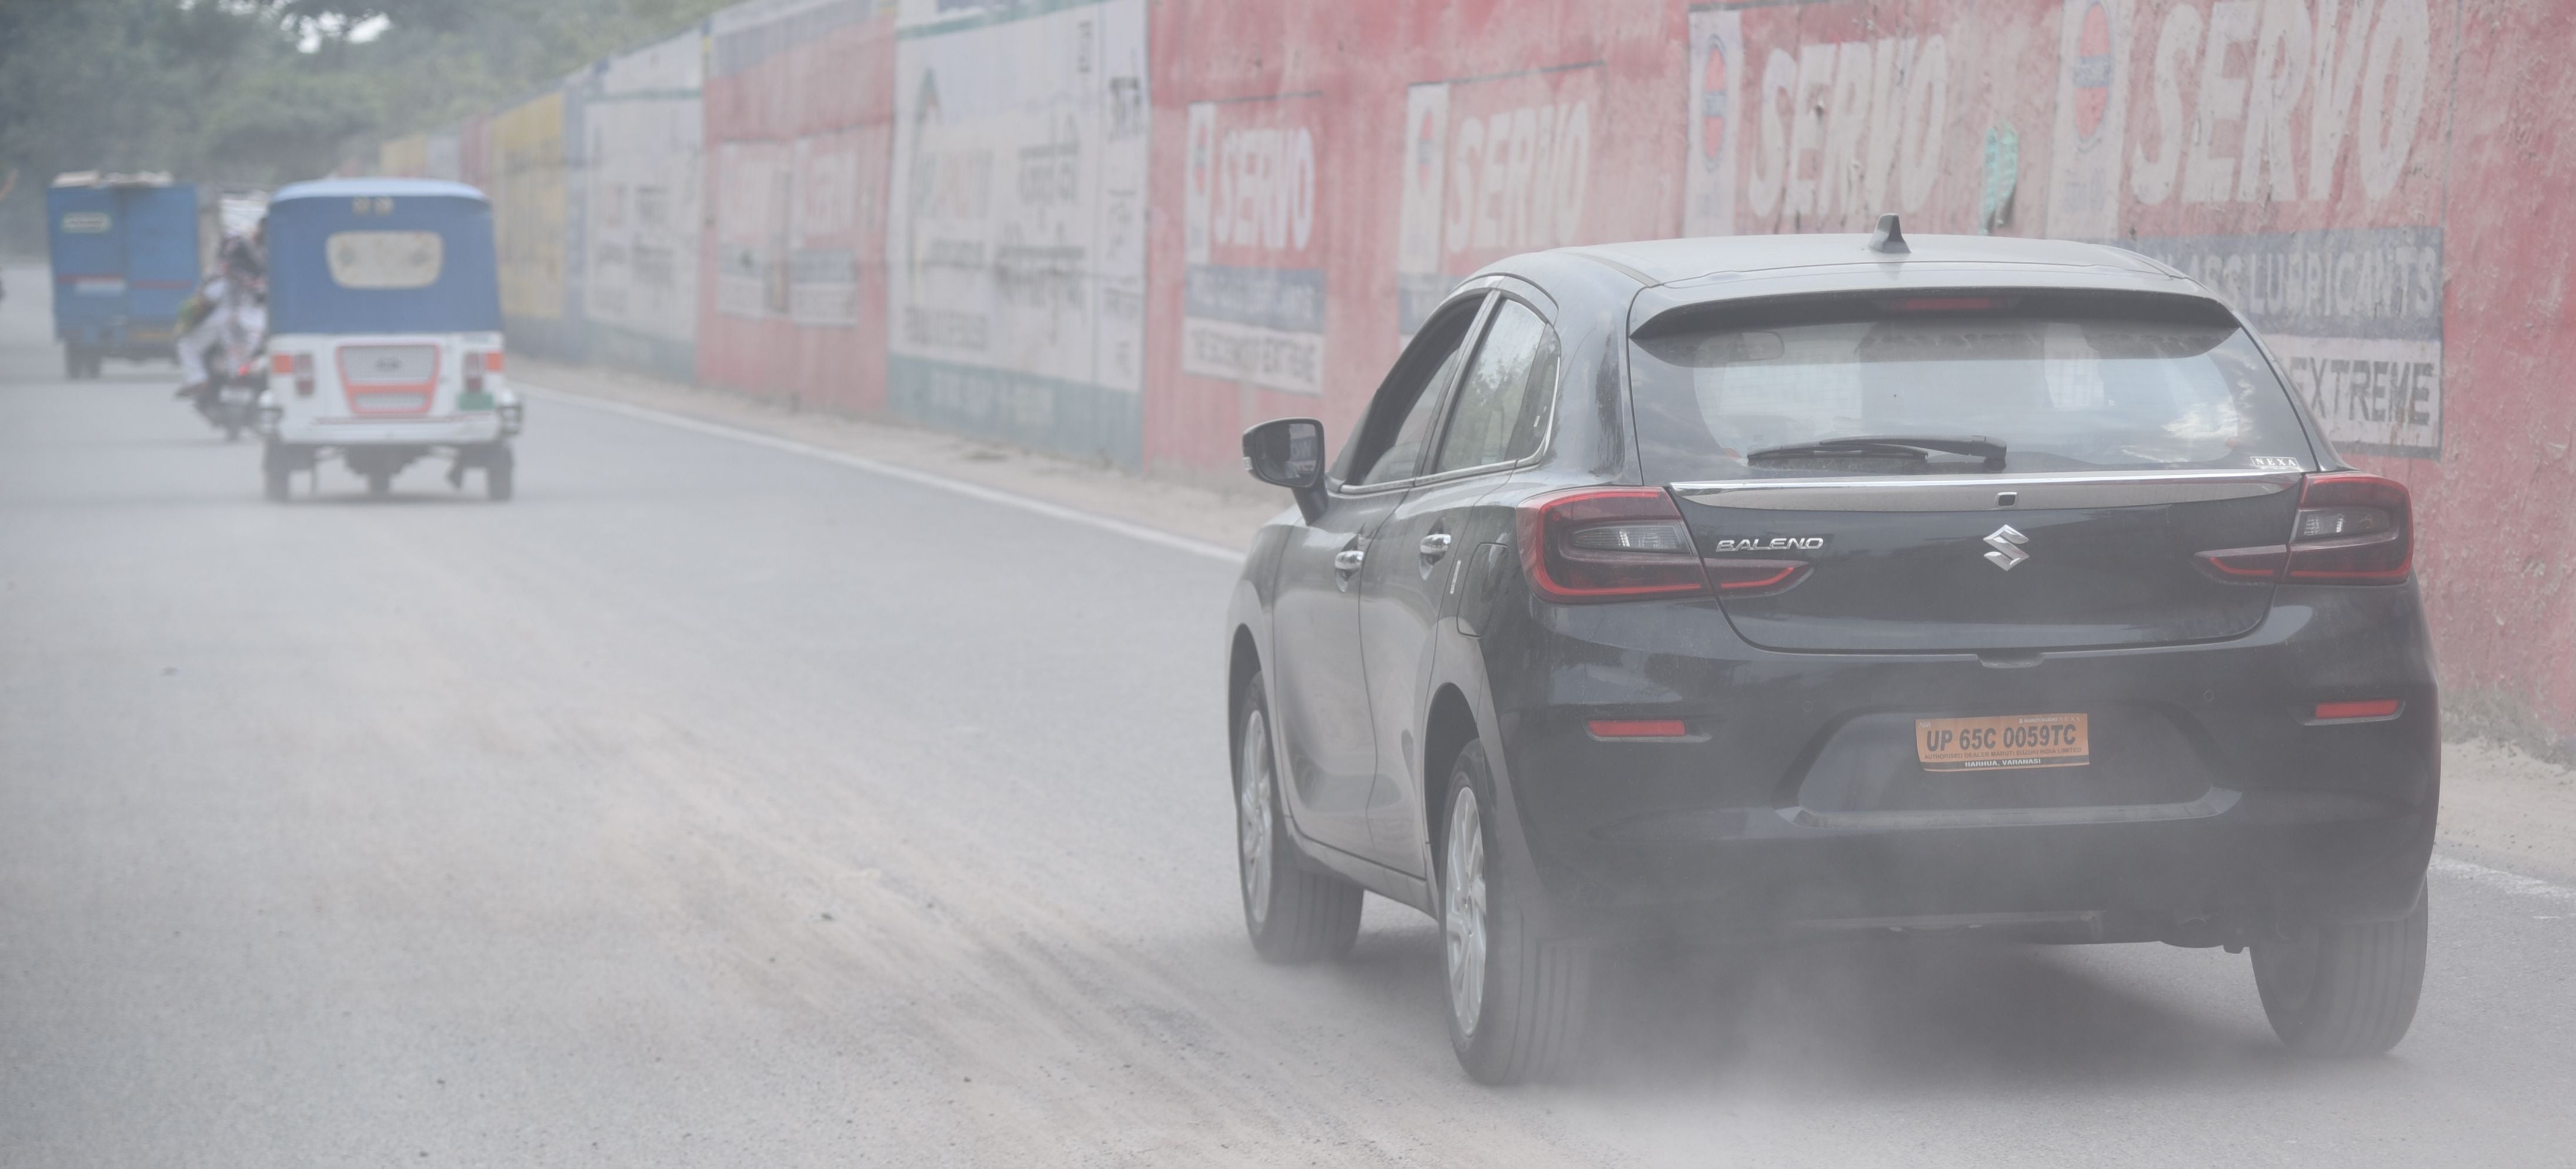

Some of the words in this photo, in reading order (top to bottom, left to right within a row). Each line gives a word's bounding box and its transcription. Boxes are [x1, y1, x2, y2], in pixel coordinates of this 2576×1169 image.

[1749, 34, 1948, 218] SERVO
[2130, 0, 2430, 204] SERVO
[1215, 126, 1315, 251] SERVO
[1445, 99, 1589, 252] SERVO
[2250, 245, 2437, 318] LUBRICANTS
[2290, 356, 2435, 426] EXTREME
[2254, 457, 2297, 466] NEXA
[1716, 537, 1824, 552] BALENO
[1927, 730, 1953, 751] UP
[1959, 728, 1996, 750] 65C
[2003, 724, 2076, 748] 0059TC
